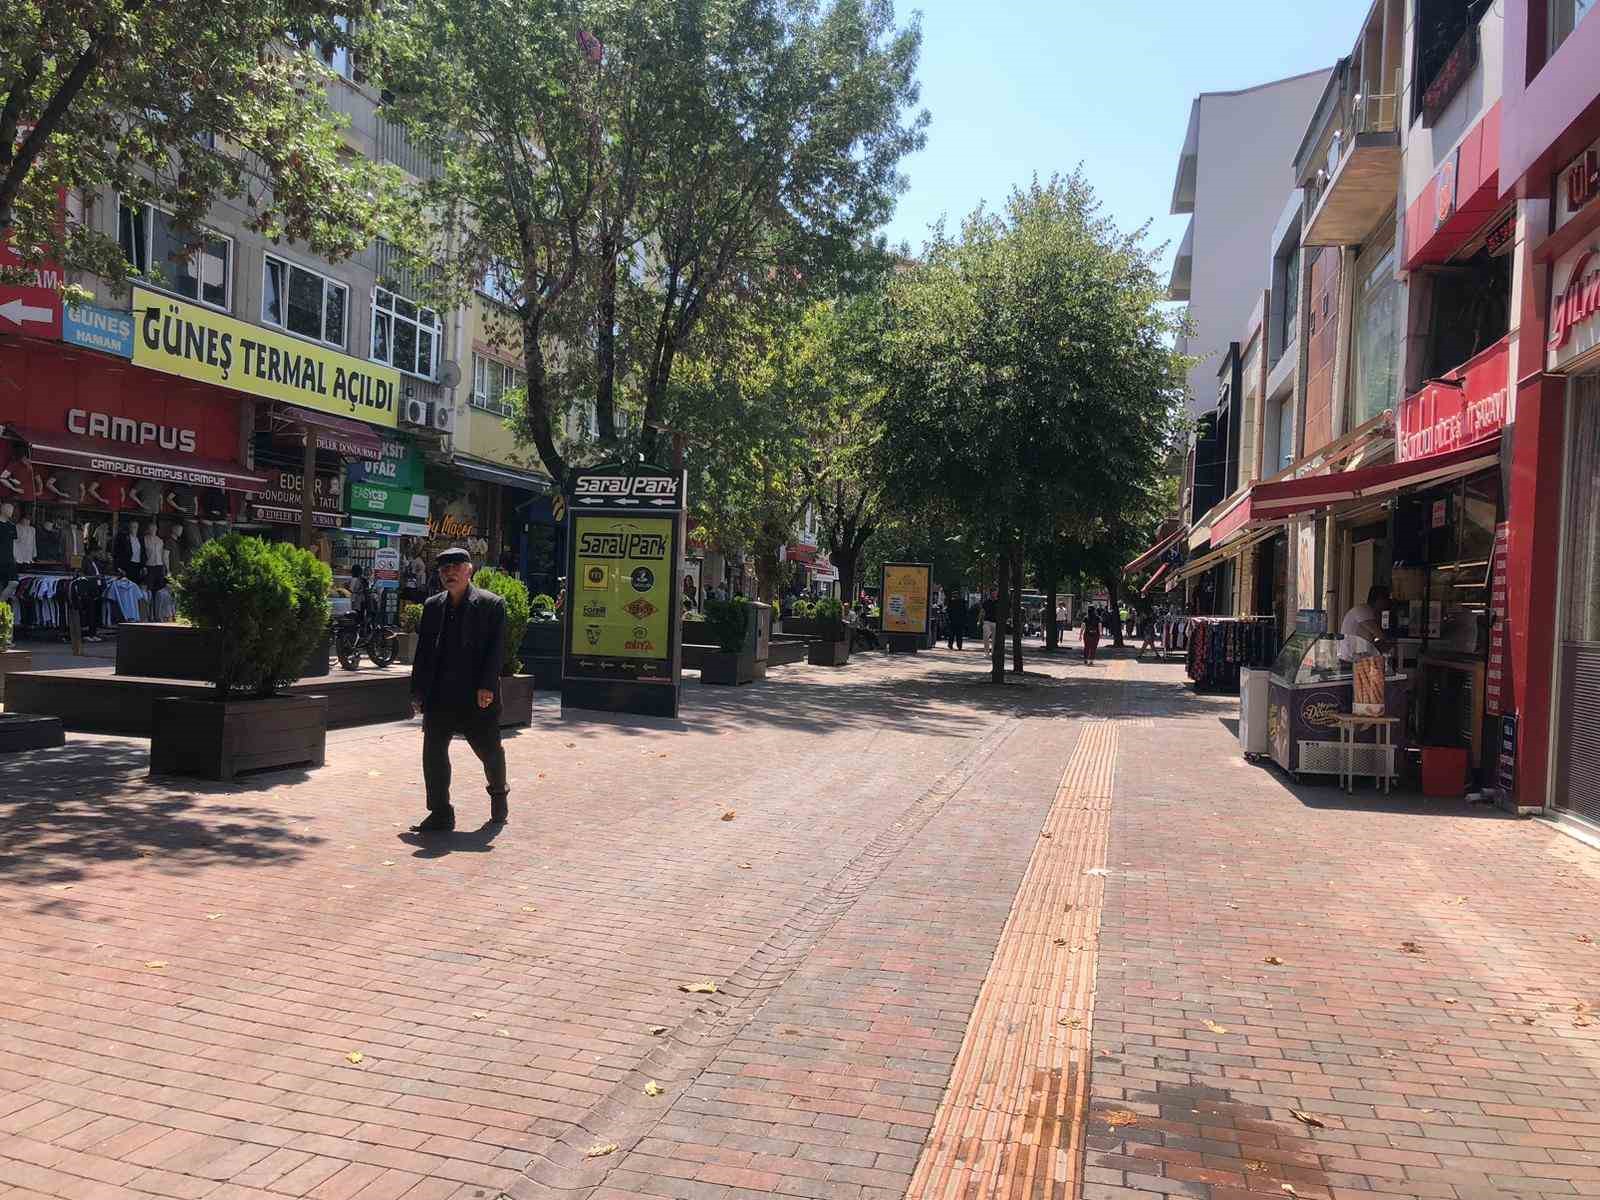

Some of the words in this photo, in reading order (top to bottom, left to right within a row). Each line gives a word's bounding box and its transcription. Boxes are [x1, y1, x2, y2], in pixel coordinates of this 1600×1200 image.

[68, 304, 130, 340] GÜNEŞ
[143, 304, 232, 380] GÜNEŞ
[240, 338, 327, 395] TERMAL
[333, 367, 394, 412] AÇILDI
[68, 408, 197, 453] CAMPUS
